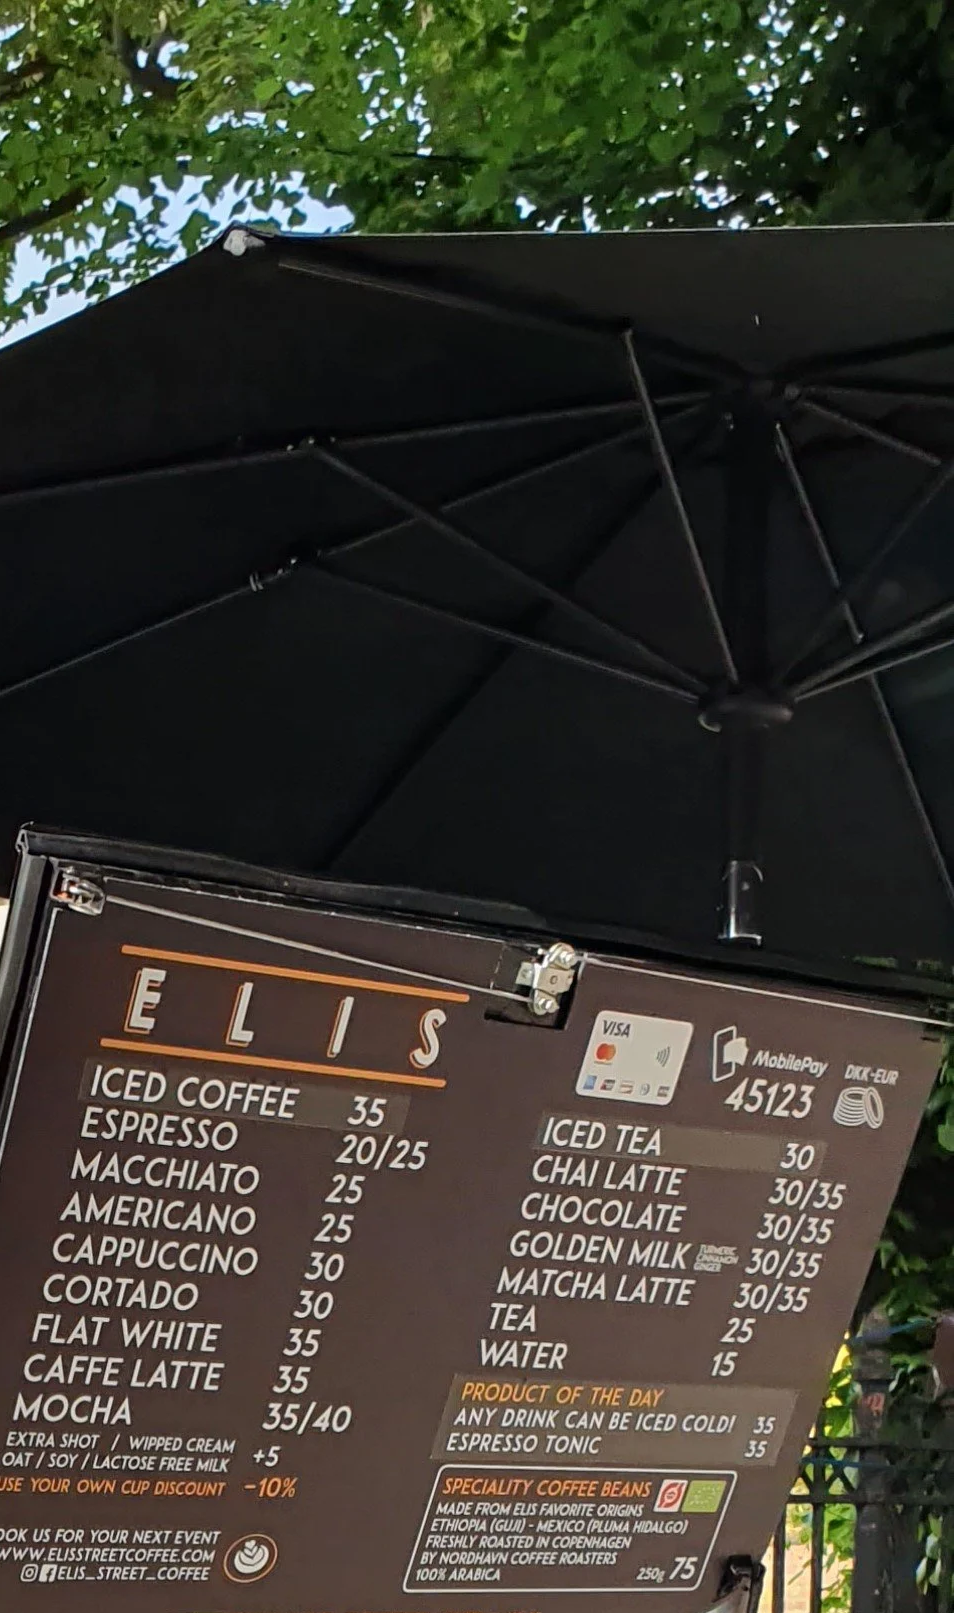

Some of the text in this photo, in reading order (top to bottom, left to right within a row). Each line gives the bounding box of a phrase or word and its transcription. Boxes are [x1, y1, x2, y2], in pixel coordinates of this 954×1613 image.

[124, 968, 447, 1068] ELIS
[601, 1019, 631, 1038] VISA
[752, 1050, 830, 1079] MobilePay
[845, 1064, 899, 1087] DKK-EUR
[90, 1065, 386, 1127] ICED COFFEE 35
[724, 1079, 816, 1119] 45123
[80, 1107, 429, 1171] ESPRESSO 20/25
[542, 1116, 816, 1171] ICED TEA 30
[70, 1149, 365, 1205] MACCHIATO 25
[531, 1155, 846, 1211] CHAI LATTE 30/35
[60, 1192, 354, 1243] AMERICANO 25
[520, 1191, 835, 1245] CHOCOLATE 30/35
[53, 1233, 344, 1282] CAPPUCCINO 30
[509, 1230, 823, 1280] GOLDEN MILK 30/35
[43, 1274, 334, 1320] CORTADO 30
[496, 1267, 811, 1313] MATCHA LATTE 30/35
[31, 1313, 321, 1357] FLAT WHITE 35
[489, 1303, 756, 1344] TEA 25
[23, 1354, 311, 1394] CAFFE LATTE 35
[480, 1339, 737, 1377] WATER 15
[460, 1381, 666, 1408] PRODUCT OF THE DAY
[12, 1392, 352, 1434] MOCHA 35/40
[454, 1408, 776, 1434] ANY DRINK CAN BE ICED COLD! 35
[6, 1431, 55, 1449] EXTRA
[60, 1433, 99, 1450] SHOT
[129, 1435, 182, 1452] WIPPED
[186, 1438, 236, 1454] CREAM
[253, 1446, 281, 1468] +5
[446, 1433, 768, 1458] ESPRESSO TONIC 35
[2, 1452, 32, 1469] OAT
[48, 1453, 79, 1469] SOY
[93, 1454, 155, 1471] LACTOSE
[158, 1456, 193, 1472] FREE
[196, 1457, 229, 1472] MILK
[31, 1478, 70, 1494] YOUR
[77, 1479, 116, 1495] OWN
[121, 1480, 150, 1495] CUP
[154, 1481, 226, 1497] DISCOUNT
[245, 1476, 297, 1498] -10%
[442, 1478, 651, 1498] SPECIALITY COFFEE BEANS
[435, 1502, 644, 1517] MADE FROM ELIS FAVORITE ORIGINS
[32, 1528, 50, 1542] US
[55, 1528, 85, 1543] FOR
[90, 1530, 128, 1544] YOUR
[133, 1530, 172, 1544] NEXT
[174, 1530, 222, 1545] EVENT
[425, 1535, 632, 1549] FRESHLY ROASTED IN COPENHAGEN
[430, 1518, 487, 1532] ETHIOPIA
[490, 1518, 525, 1534] (GUJI)
[536, 1520, 585, 1533] MEXICO
[587, 1519, 630, 1534] (PLUMA
[632, 1519, 689, 1535] HIDALGO)
[57, 1566, 210, 1581] ELIS_STREET_COFFEE
[415, 1557, 698, 1583] 100% ARABICA 250g 75
[420, 1551, 618, 1565] BY NORDHAVN COFFEE ROASTERS
